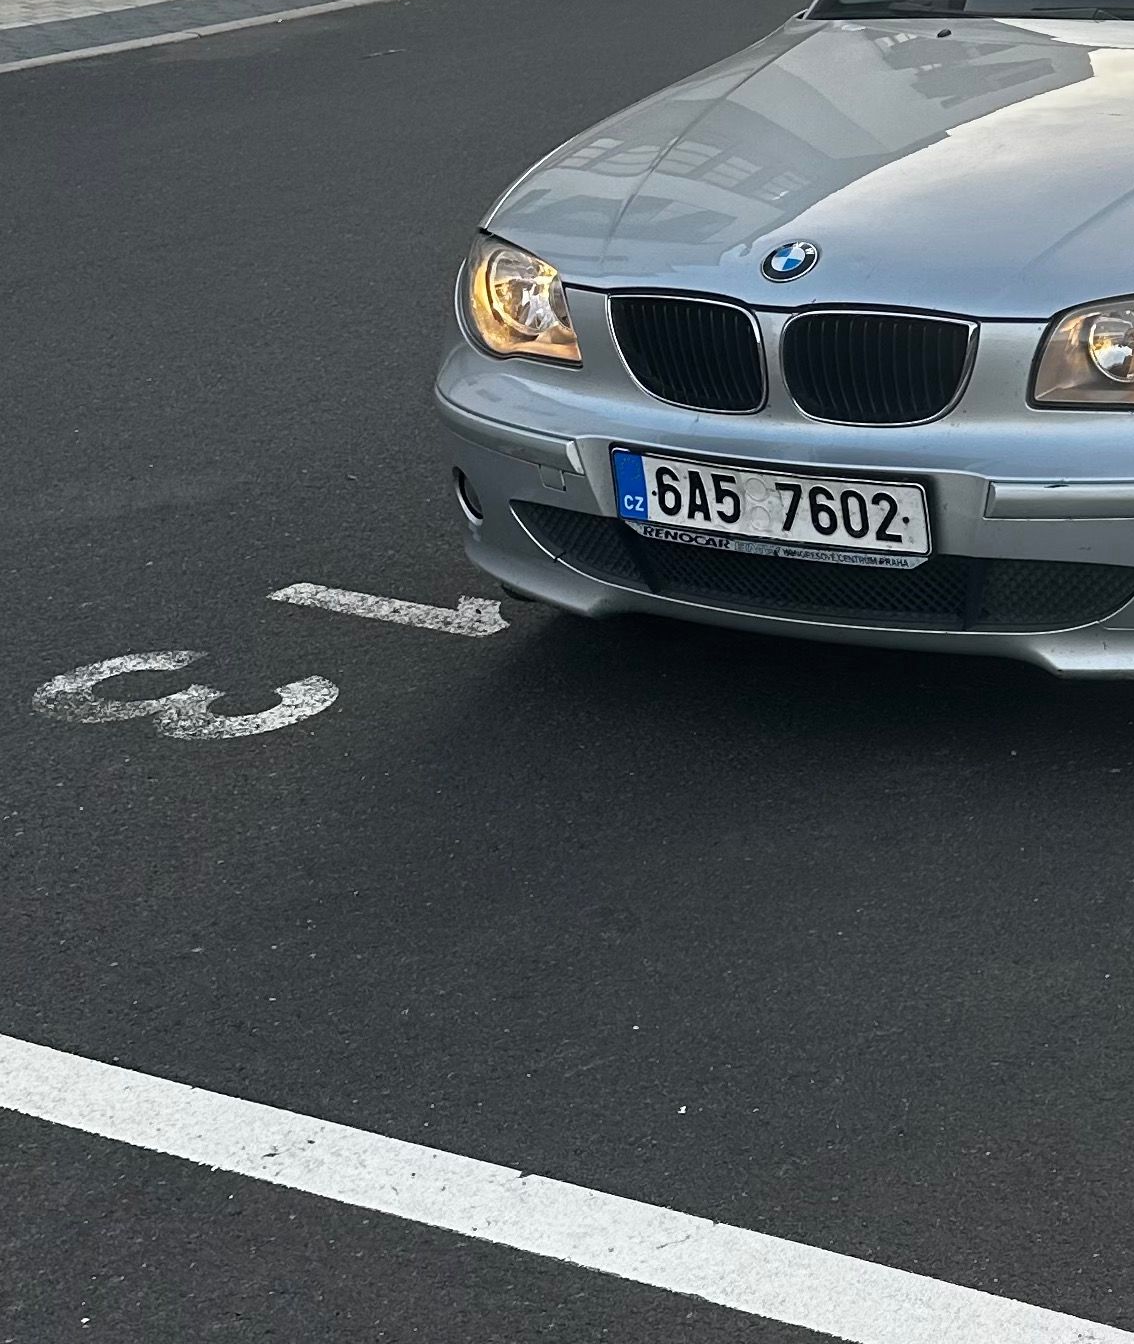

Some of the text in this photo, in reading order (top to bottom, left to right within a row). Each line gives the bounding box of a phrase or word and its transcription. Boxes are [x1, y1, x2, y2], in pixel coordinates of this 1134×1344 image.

[624, 494, 645, 512] CZ
[655, 466, 903, 543] 6A5 7602
[643, 525, 730, 548] RENOCAR
[32, 582, 511, 741] 13
